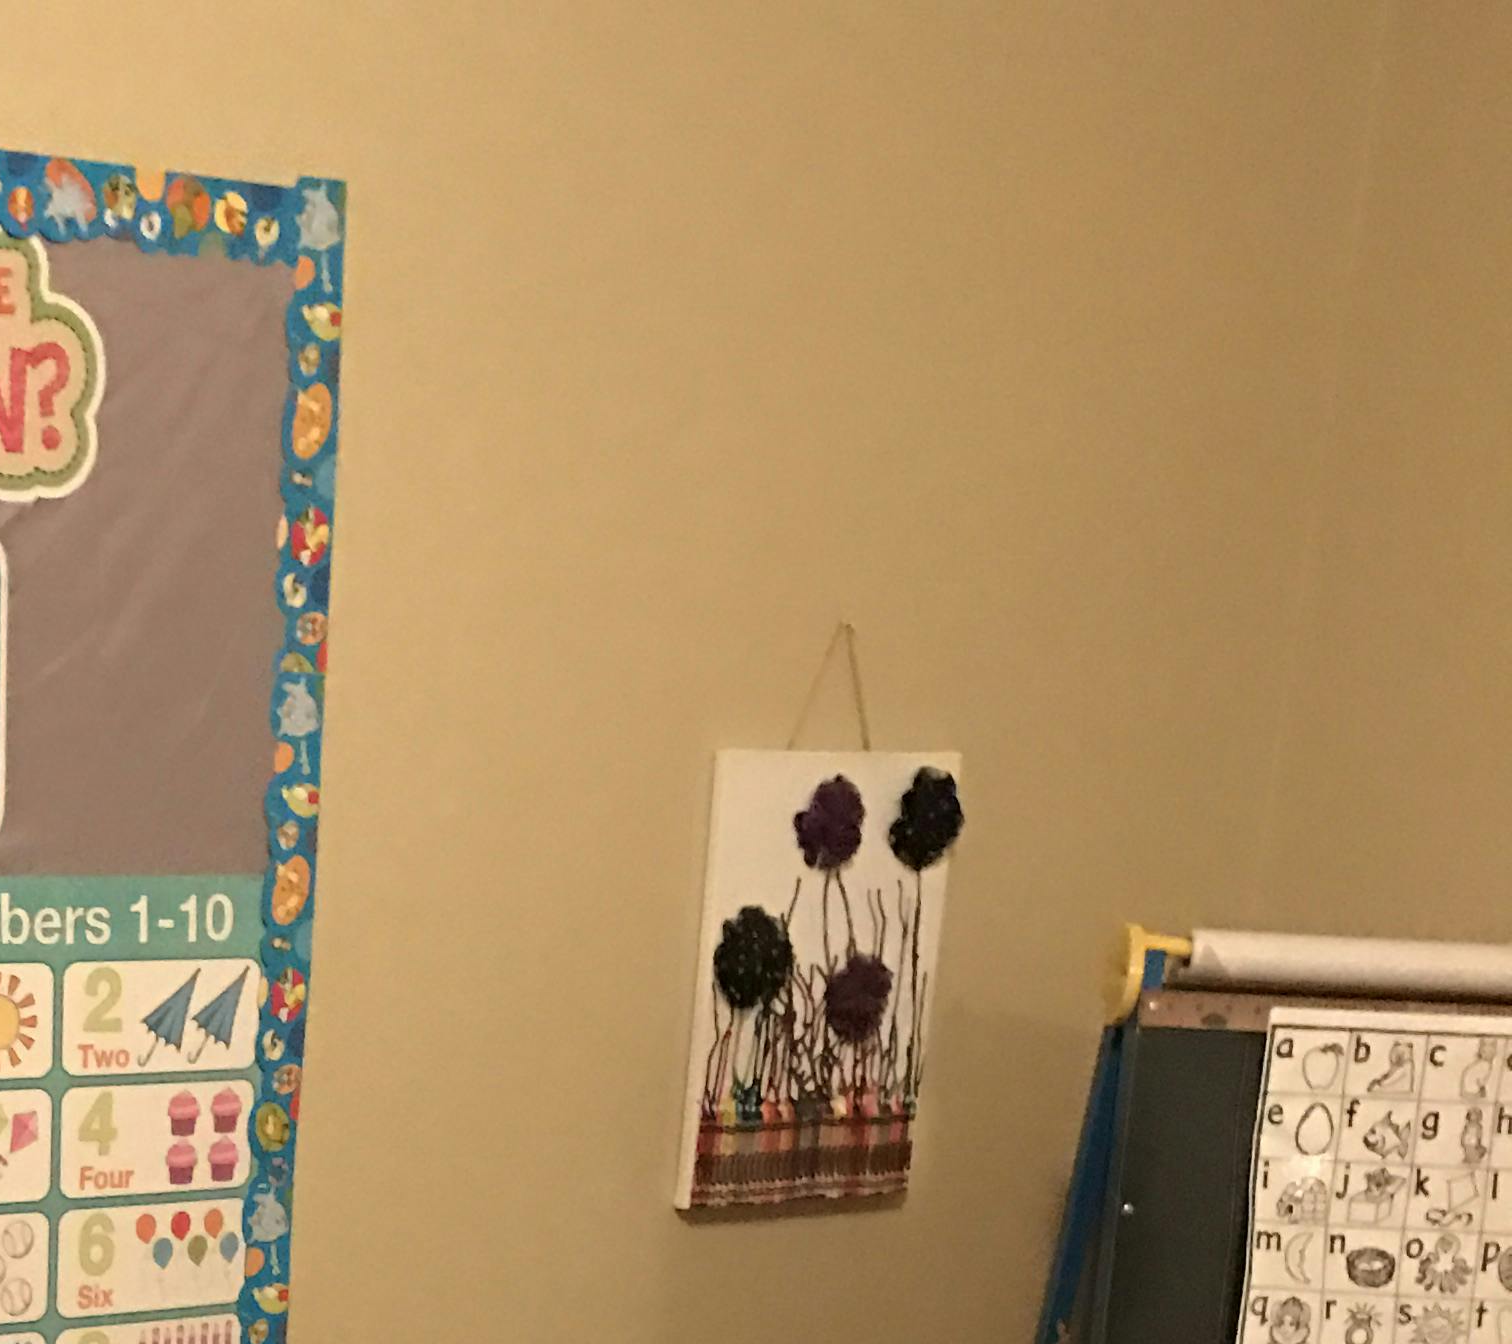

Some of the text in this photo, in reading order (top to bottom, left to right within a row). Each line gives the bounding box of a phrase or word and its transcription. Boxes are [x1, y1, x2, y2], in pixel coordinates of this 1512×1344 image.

[129, 893, 234, 945] 1-10
[83, 967, 122, 1034] 2
[78, 1044, 130, 1069] Two
[1276, 1037, 1294, 1059] a
[1353, 1034, 1371, 1064] b
[1429, 1044, 1447, 1067] c
[78, 1090, 118, 1156] 4
[1267, 1104, 1284, 1125] e
[1346, 1098, 1360, 1128] f
[1421, 1110, 1440, 1140] g
[79, 1165, 134, 1190] Four
[1262, 1160, 1270, 1189] i
[1335, 1161, 1350, 1199] j
[1414, 1167, 1431, 1197] k
[78, 1212, 116, 1277] 6
[1255, 1229, 1281, 1251] m
[1329, 1233, 1346, 1254] n
[1405, 1238, 1424, 1259] o
[1480, 1241, 1501, 1272] p
[78, 1285, 113, 1310] Six
[1250, 1295, 1269, 1326] q
[1324, 1299, 1337, 1320] r
[1398, 1304, 1413, 1325] s
[1475, 1301, 1488, 1328] t
